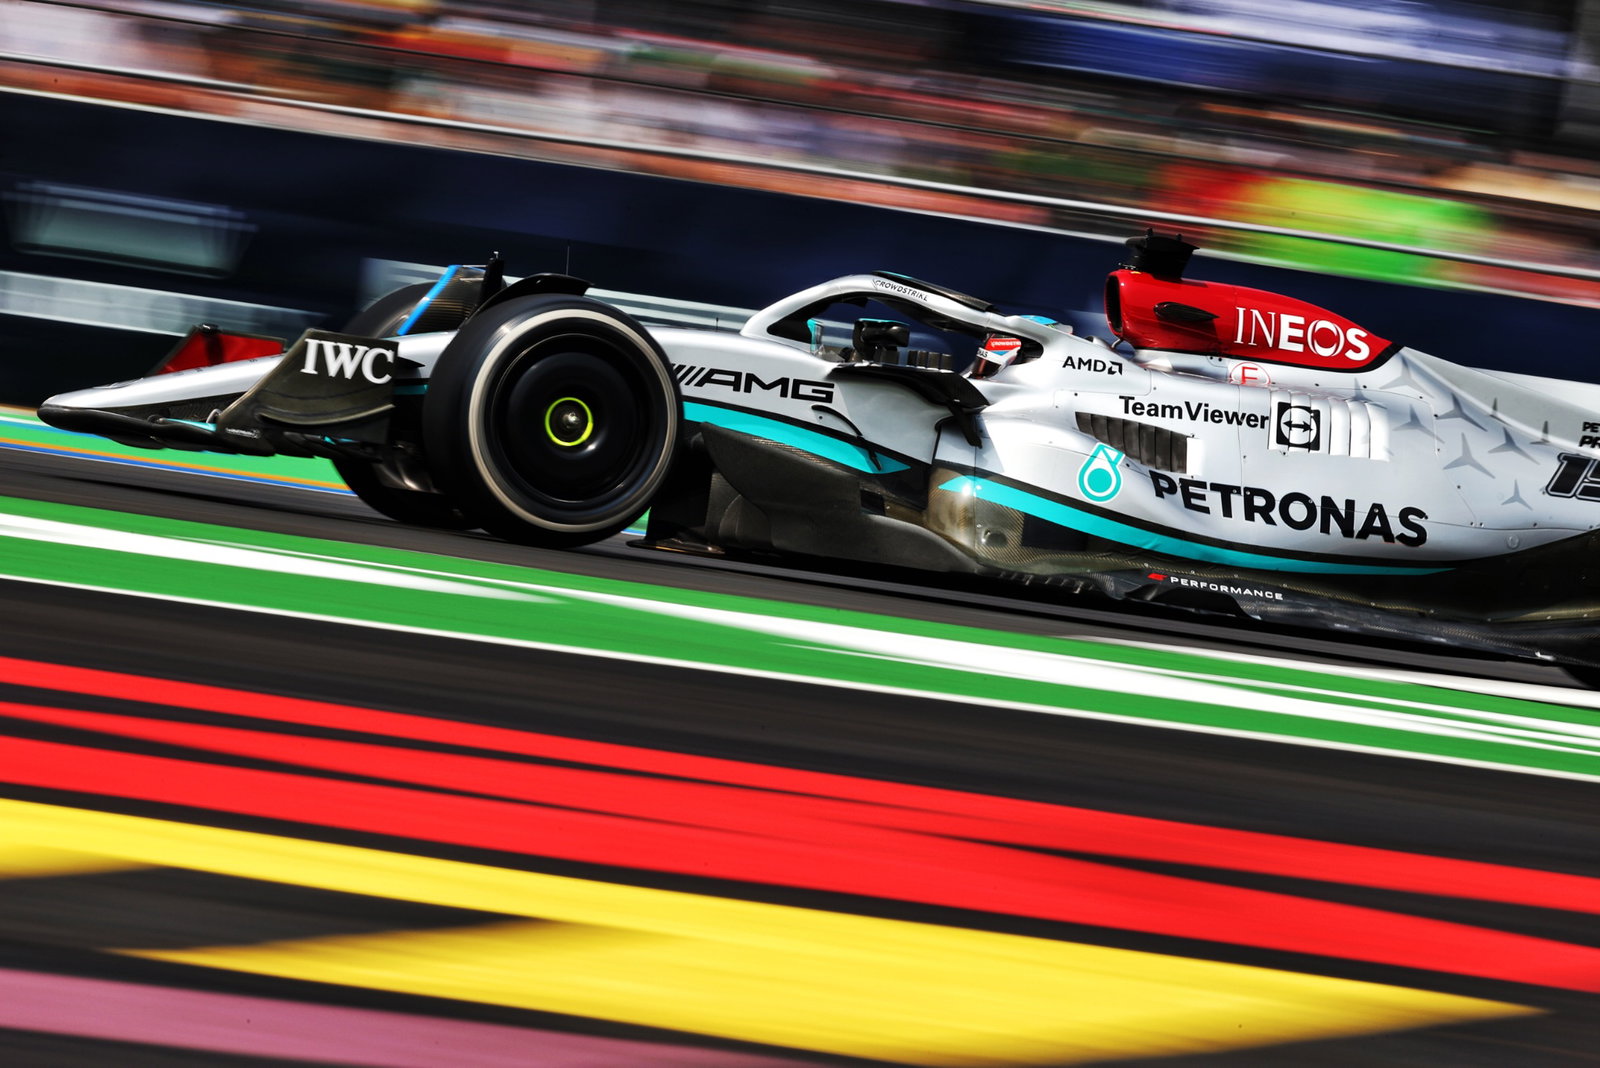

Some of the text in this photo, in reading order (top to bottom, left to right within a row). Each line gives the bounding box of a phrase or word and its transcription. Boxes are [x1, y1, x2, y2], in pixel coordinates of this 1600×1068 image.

[1234, 306, 1370, 361] INEOS
[300, 338, 395, 384] IWC
[1062, 355, 1107, 373] AMD
[1118, 395, 1269, 429] TeamViewer
[1582, 421, 1600, 433] PE
[1148, 469, 1428, 548] PETRONAS
[1170, 576, 1284, 600] PERFORMANCE
